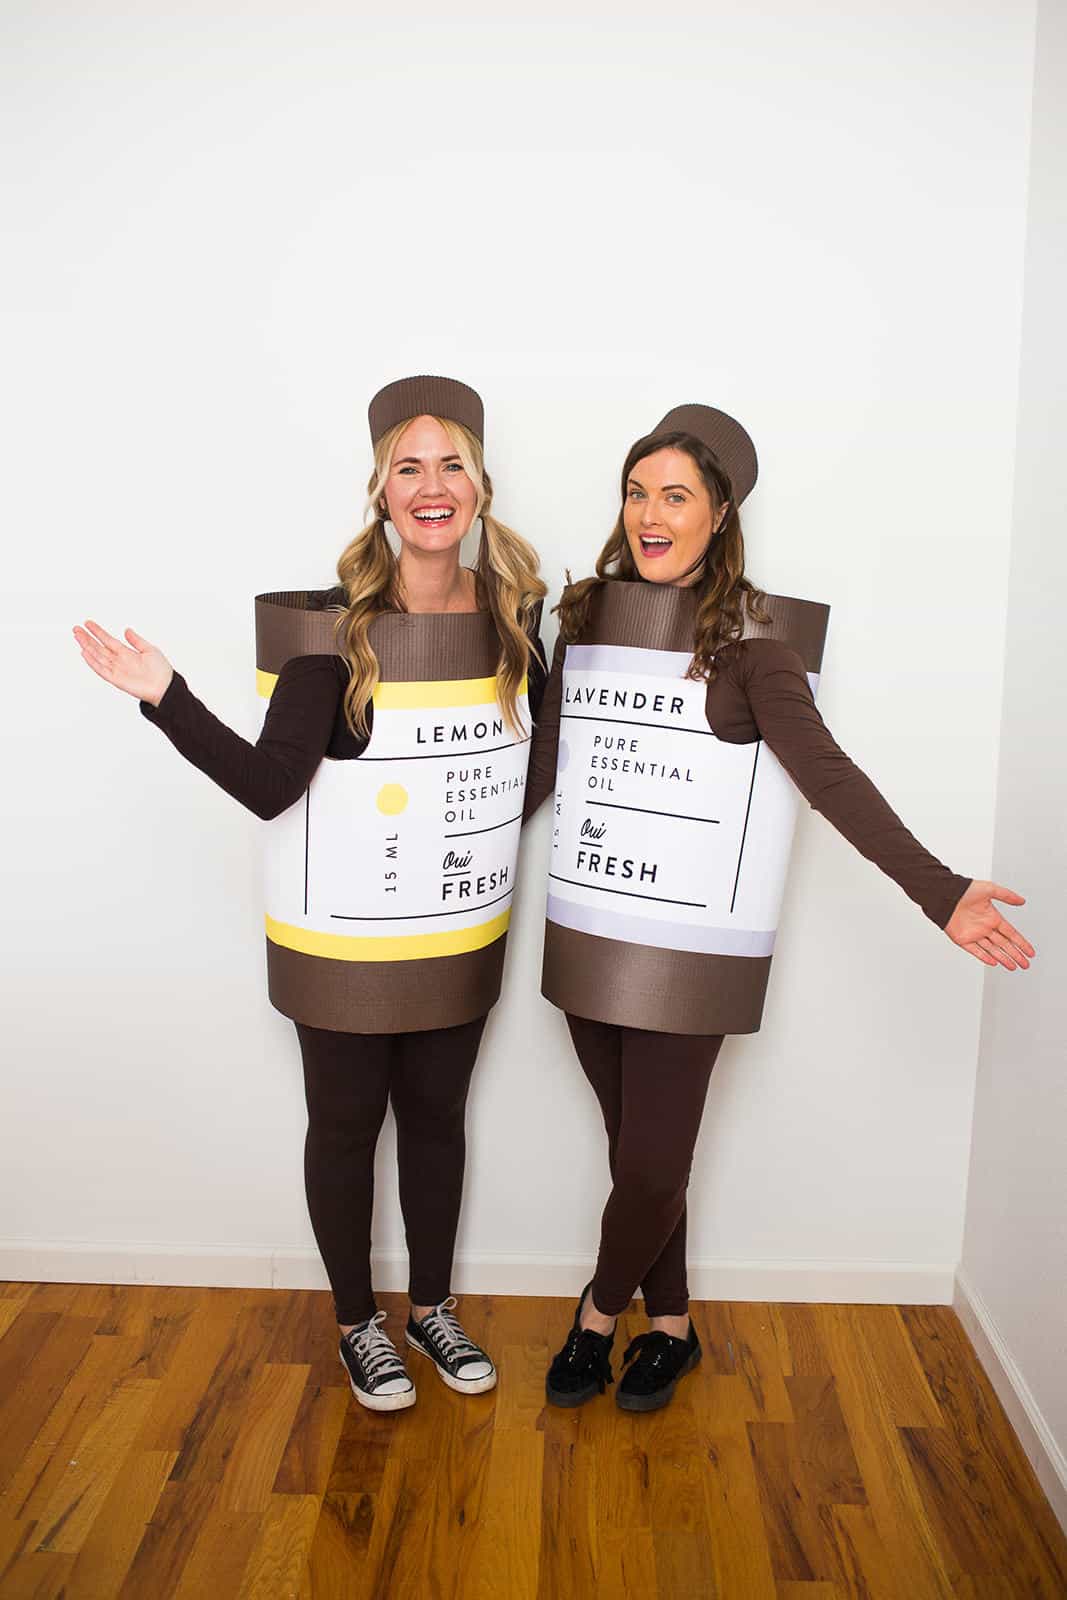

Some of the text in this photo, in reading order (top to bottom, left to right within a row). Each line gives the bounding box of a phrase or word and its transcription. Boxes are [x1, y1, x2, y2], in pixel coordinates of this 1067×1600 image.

[565, 687, 684, 715] LAVENDER
[416, 719, 504, 744] LEMON
[593, 735, 639, 752] PURE
[446, 766, 493, 783] PURE
[591, 755, 694, 782] ESSENTIAL
[445, 775, 525, 803] ESSENTIAL
[587, 776, 615, 791] OIL
[444, 810, 476, 823] OIL
[580, 818, 607, 839] Oui
[384, 833, 398, 892] 15 ML
[442, 850, 473, 870] Oui
[577, 851, 658, 883] FRESH
[442, 866, 509, 901] FRESH
